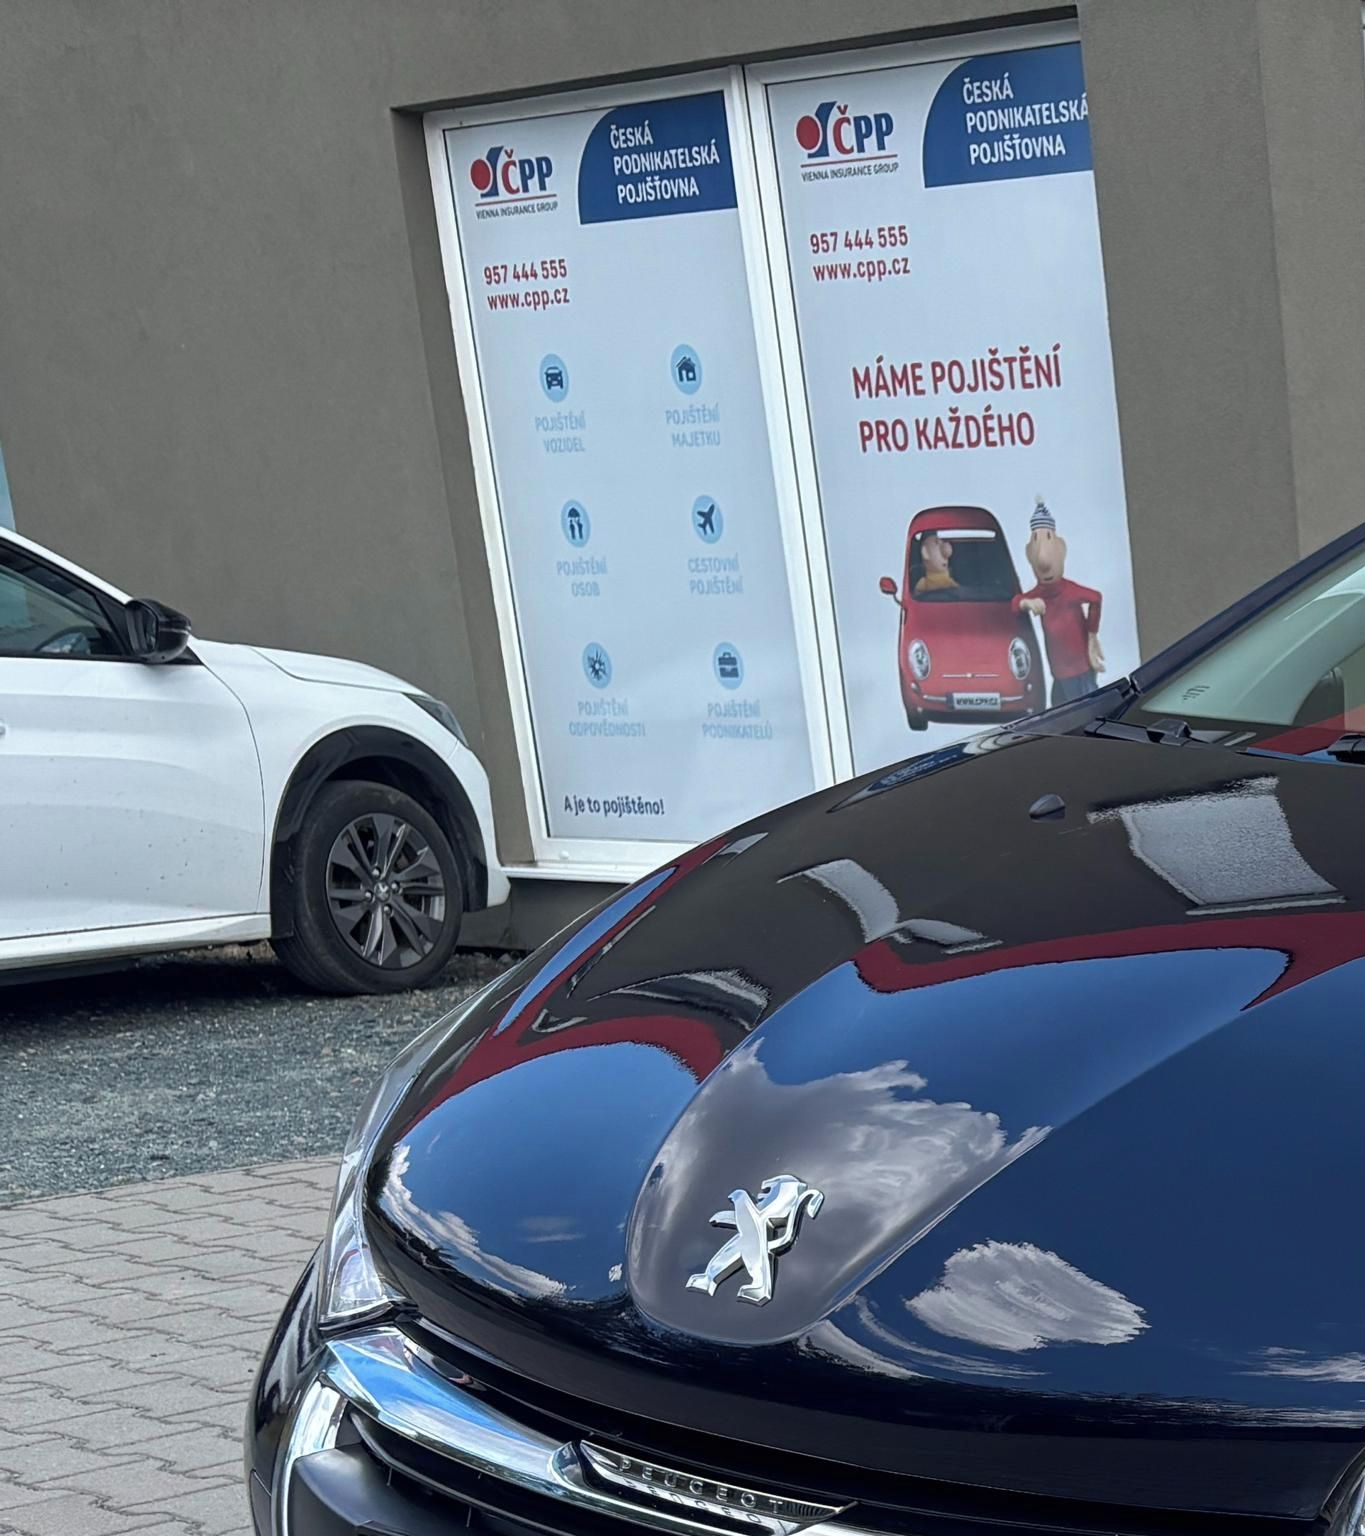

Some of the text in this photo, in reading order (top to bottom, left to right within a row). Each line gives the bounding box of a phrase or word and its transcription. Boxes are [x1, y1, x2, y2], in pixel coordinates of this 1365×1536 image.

[962, 72, 1014, 105] ČESKÁ
[965, 92, 1089, 134] PODNIKATELSKÁ
[610, 120, 653, 149] ČESKÁ
[832, 104, 894, 156] ČPP
[613, 139, 720, 176] PODNIKATELSKÁ
[969, 134, 1066, 166] POJIŠŤOVNA
[501, 149, 553, 196] ČPP
[801, 161, 900, 182] VIENNA INSURANCE GROUP
[617, 175, 700, 204] POJIŠŤOVNA
[476, 200, 559, 220] VIENNA INSURANCE GROUP
[810, 225, 909, 254] 957 444 555
[484, 258, 568, 286] 957 444 555
[812, 257, 911, 283] www.cpp.cz
[487, 287, 570, 311] www.cpp.cz
[852, 342, 1063, 400] MÁME POJIŠTĚNÍ
[535, 410, 587, 432] POJIŠTĚNÍ
[665, 403, 720, 425] POJIŠTĚNÍ
[672, 430, 721, 448] MAJETKU
[859, 404, 1036, 454] PRO KAŽDÉHO
[543, 437, 586, 454] VOZIDEL
[556, 556, 608, 577] POJIŠTĚNÍ
[687, 552, 740, 574] CESTOVNÍ
[571, 581, 600, 597] OSOB
[689, 575, 744, 596] POJIŠTĚNÍ
[577, 698, 629, 717] POJIŠTĚNÍ
[707, 699, 761, 718] POJIŠTĚNÍ
[564, 795, 665, 818] A je to pojištěno!
[620, 1457, 784, 1514] PEUGEOT
